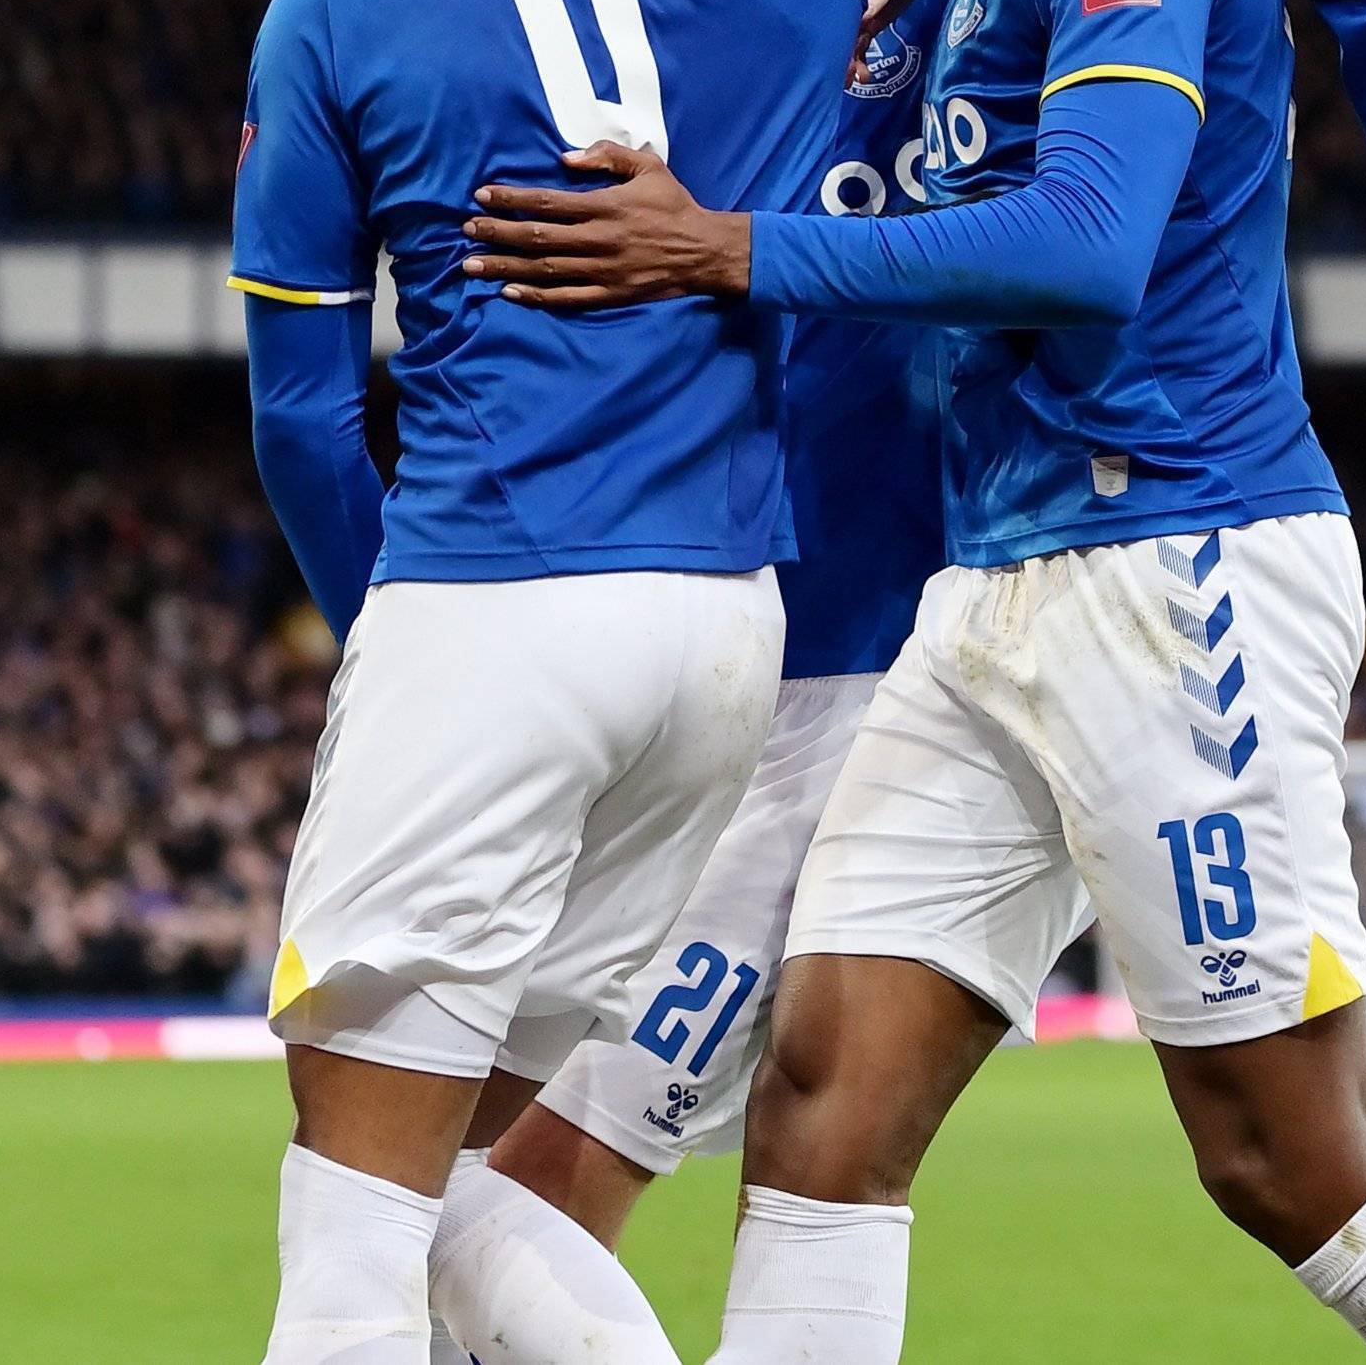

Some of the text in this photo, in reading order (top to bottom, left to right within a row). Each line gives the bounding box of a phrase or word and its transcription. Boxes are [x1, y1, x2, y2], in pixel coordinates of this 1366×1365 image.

[1156, 812, 1257, 946] 13
[631, 941, 761, 1078] 21
[1201, 980, 1261, 1005] hummel
[642, 1106, 685, 1138] hummel
